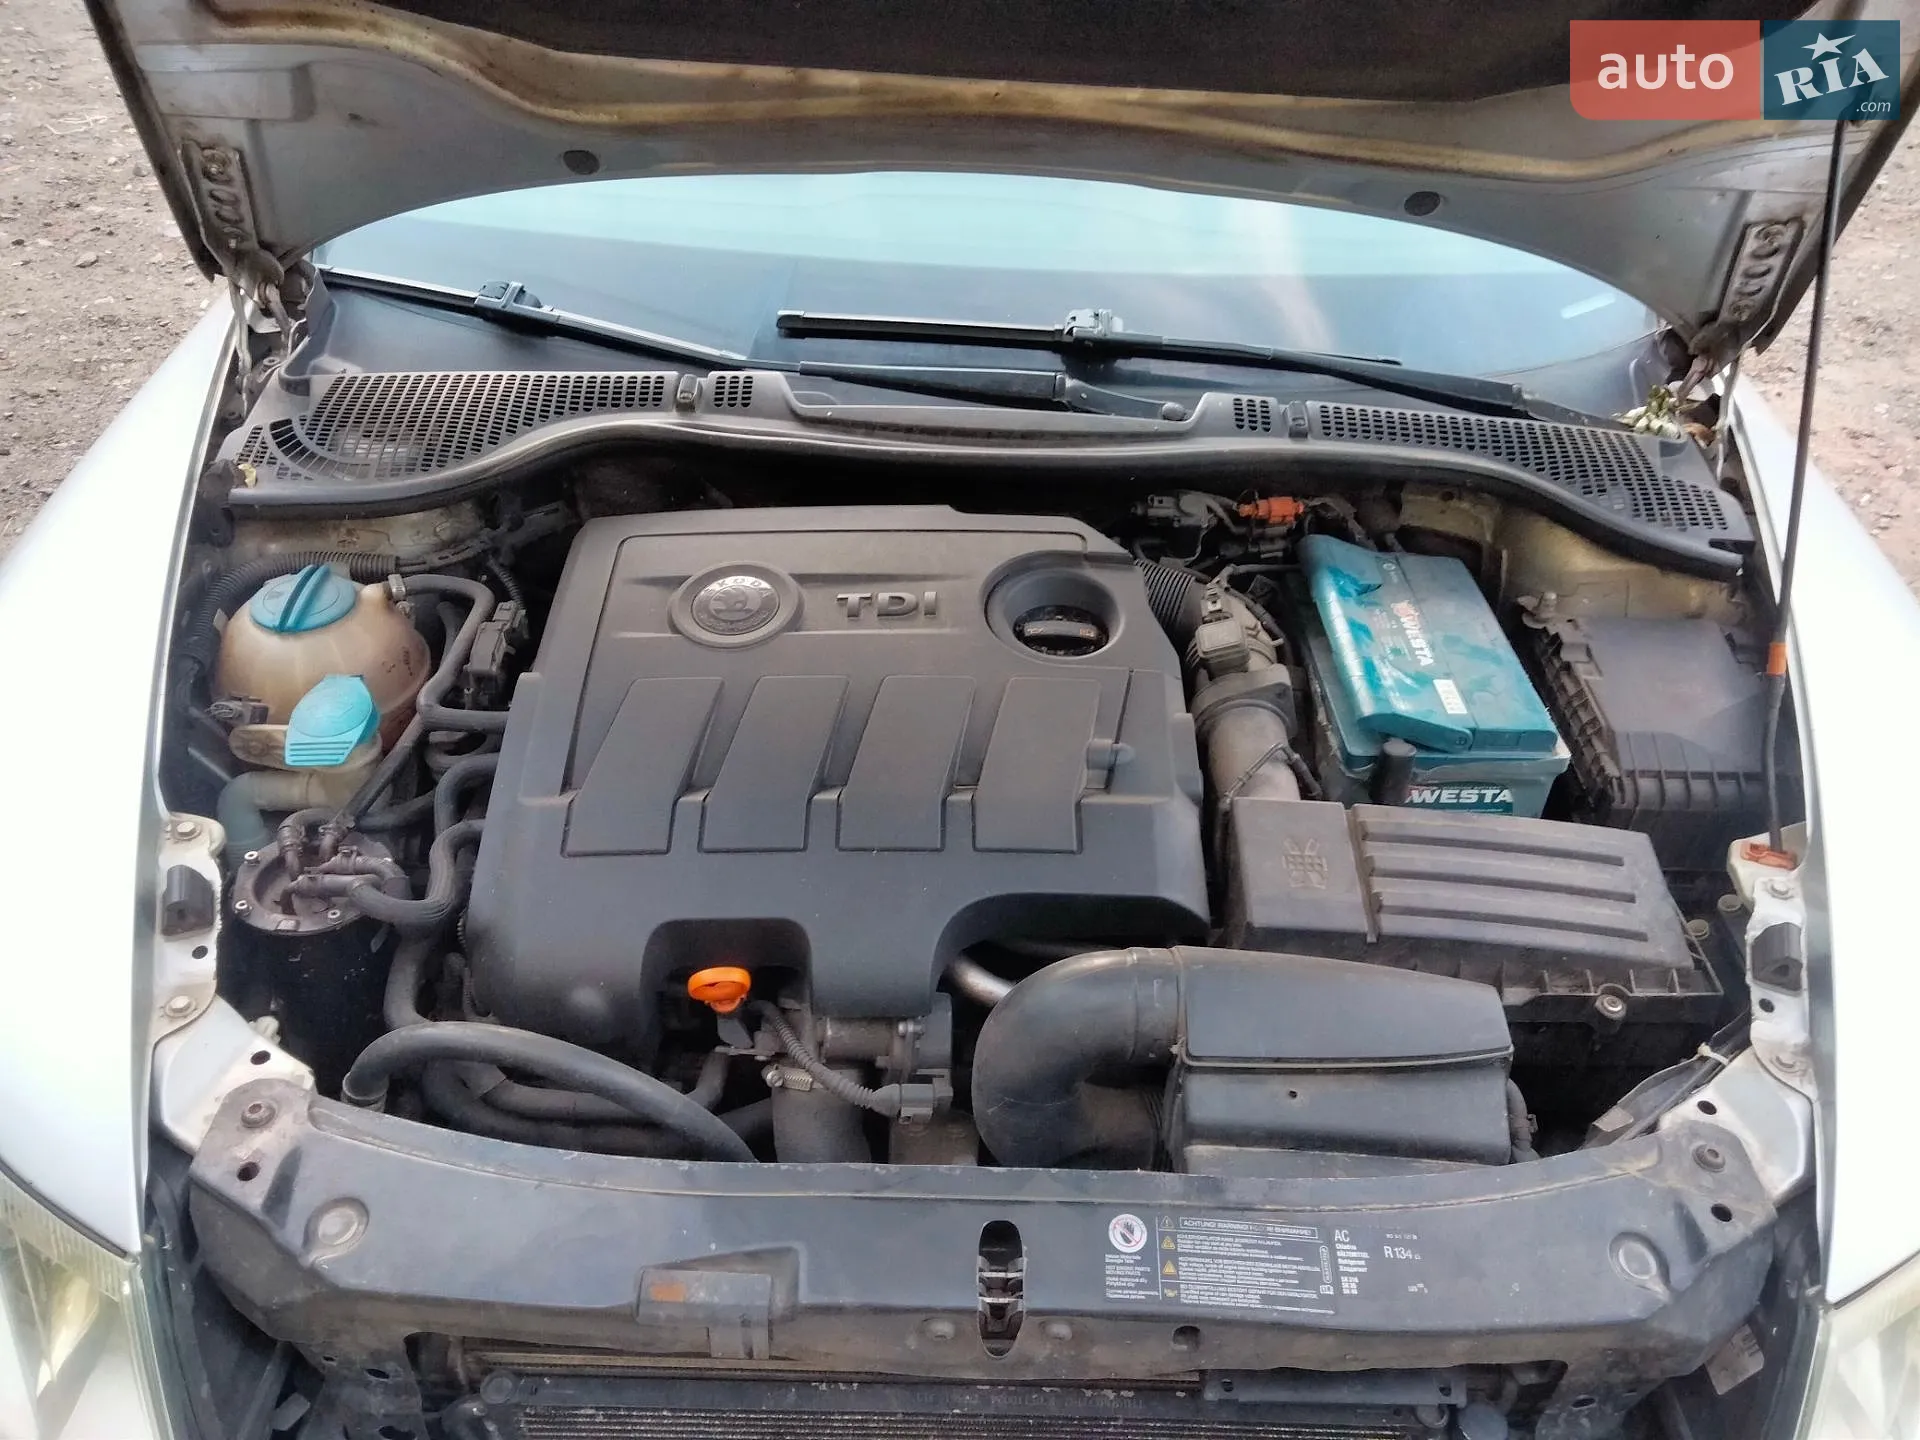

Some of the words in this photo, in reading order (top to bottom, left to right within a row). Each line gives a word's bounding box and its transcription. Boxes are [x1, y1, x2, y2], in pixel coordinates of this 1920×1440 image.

[836, 591, 938, 618] TDI
[1405, 789, 1514, 803] WESTA
[1335, 1230, 1350, 1242] AC
